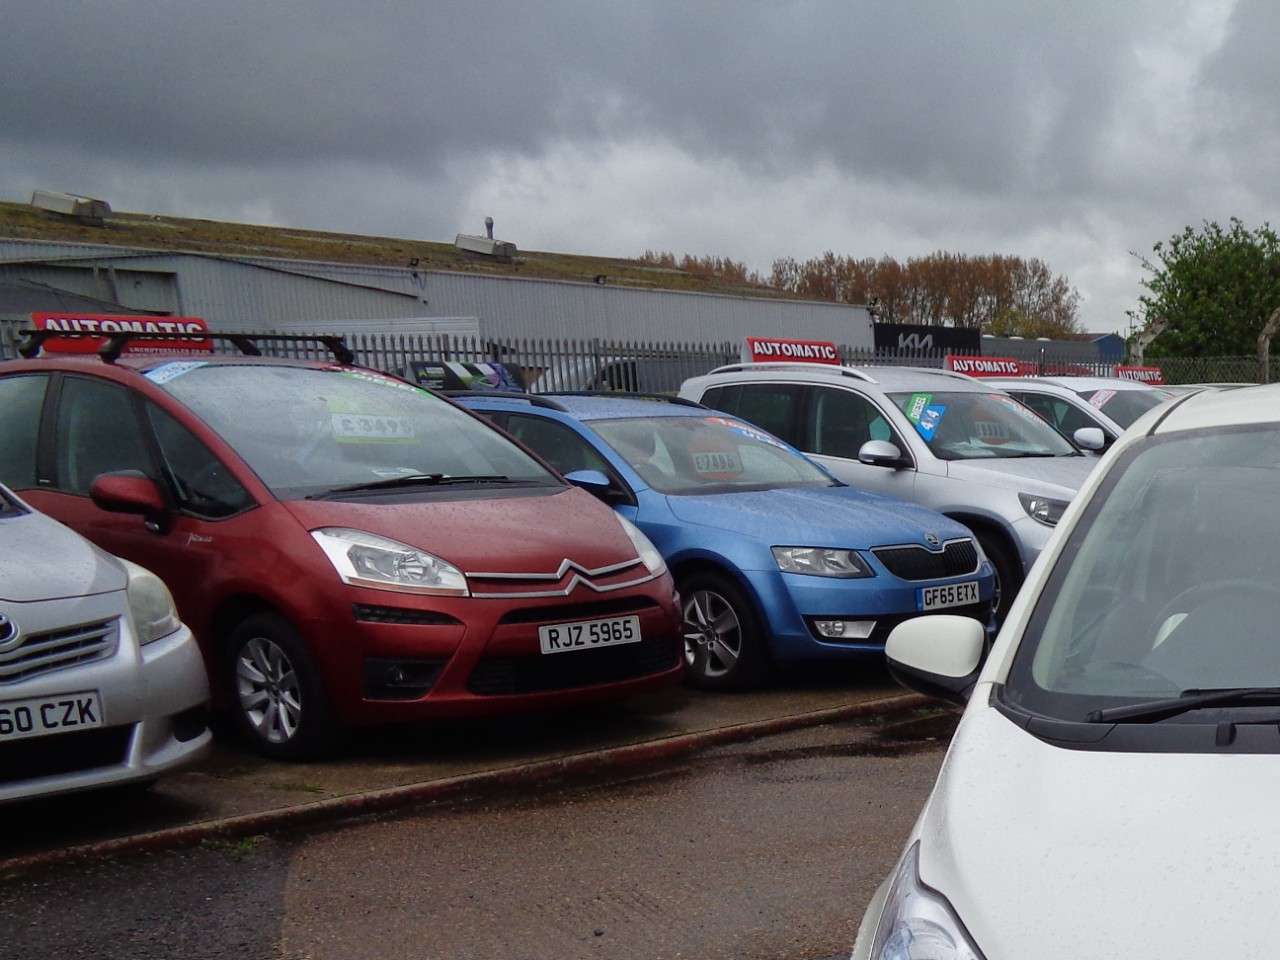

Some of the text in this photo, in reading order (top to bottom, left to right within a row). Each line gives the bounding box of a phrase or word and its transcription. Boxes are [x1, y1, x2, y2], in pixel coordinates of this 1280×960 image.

[46, 318, 204, 342] AUTOMATIC
[753, 341, 836, 359] AUTOMATIC
[952, 359, 1018, 374] AUTOMATIC
[1117, 369, 1162, 382] AUTOMATIC
[924, 584, 977, 606] GF65 ETX
[548, 620, 633, 649] RJZ 5965
[40, 698, 96, 728] CZK
